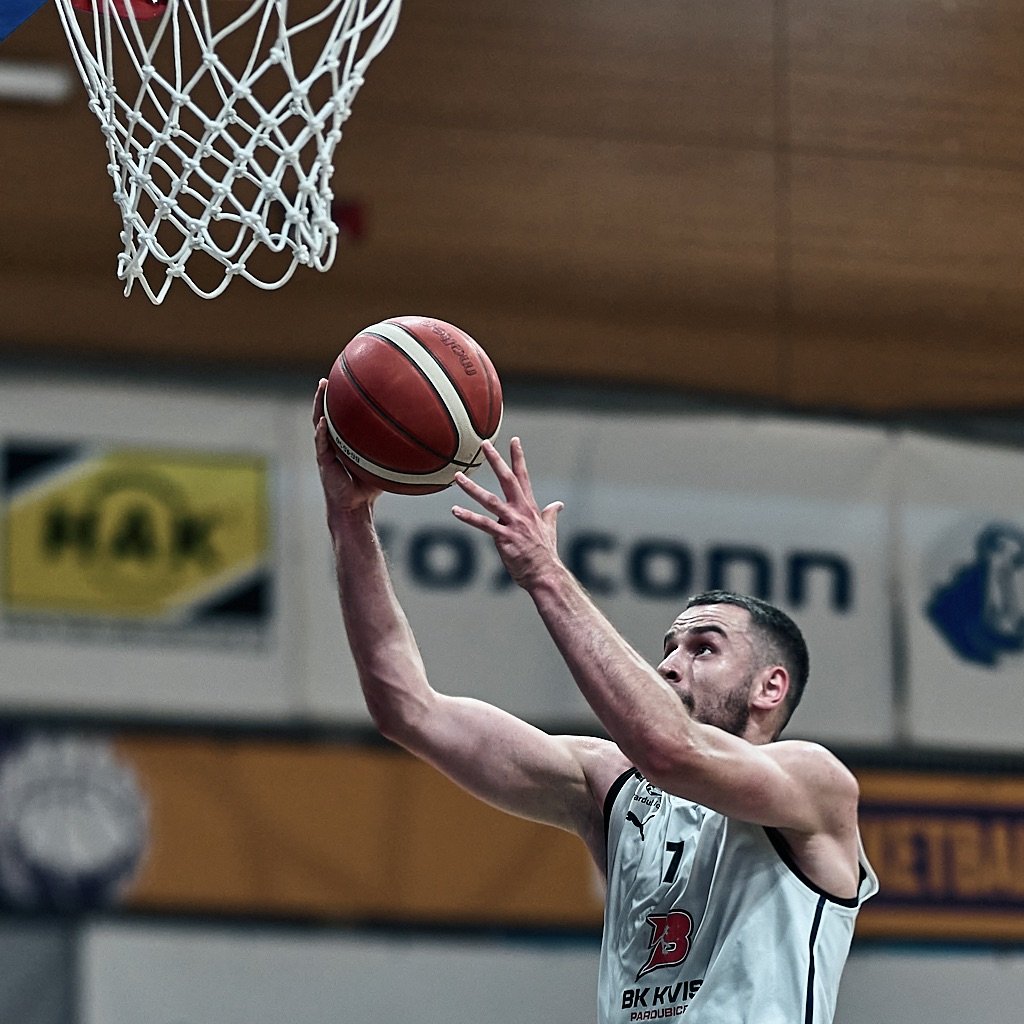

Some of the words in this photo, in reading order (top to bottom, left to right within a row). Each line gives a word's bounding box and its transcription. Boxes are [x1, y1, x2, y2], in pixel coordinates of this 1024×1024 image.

[380, 522, 853, 612] oconn
[662, 840, 685, 884] 7
[621, 988, 651, 1010] BK
[652, 979, 704, 1007] KVIS
